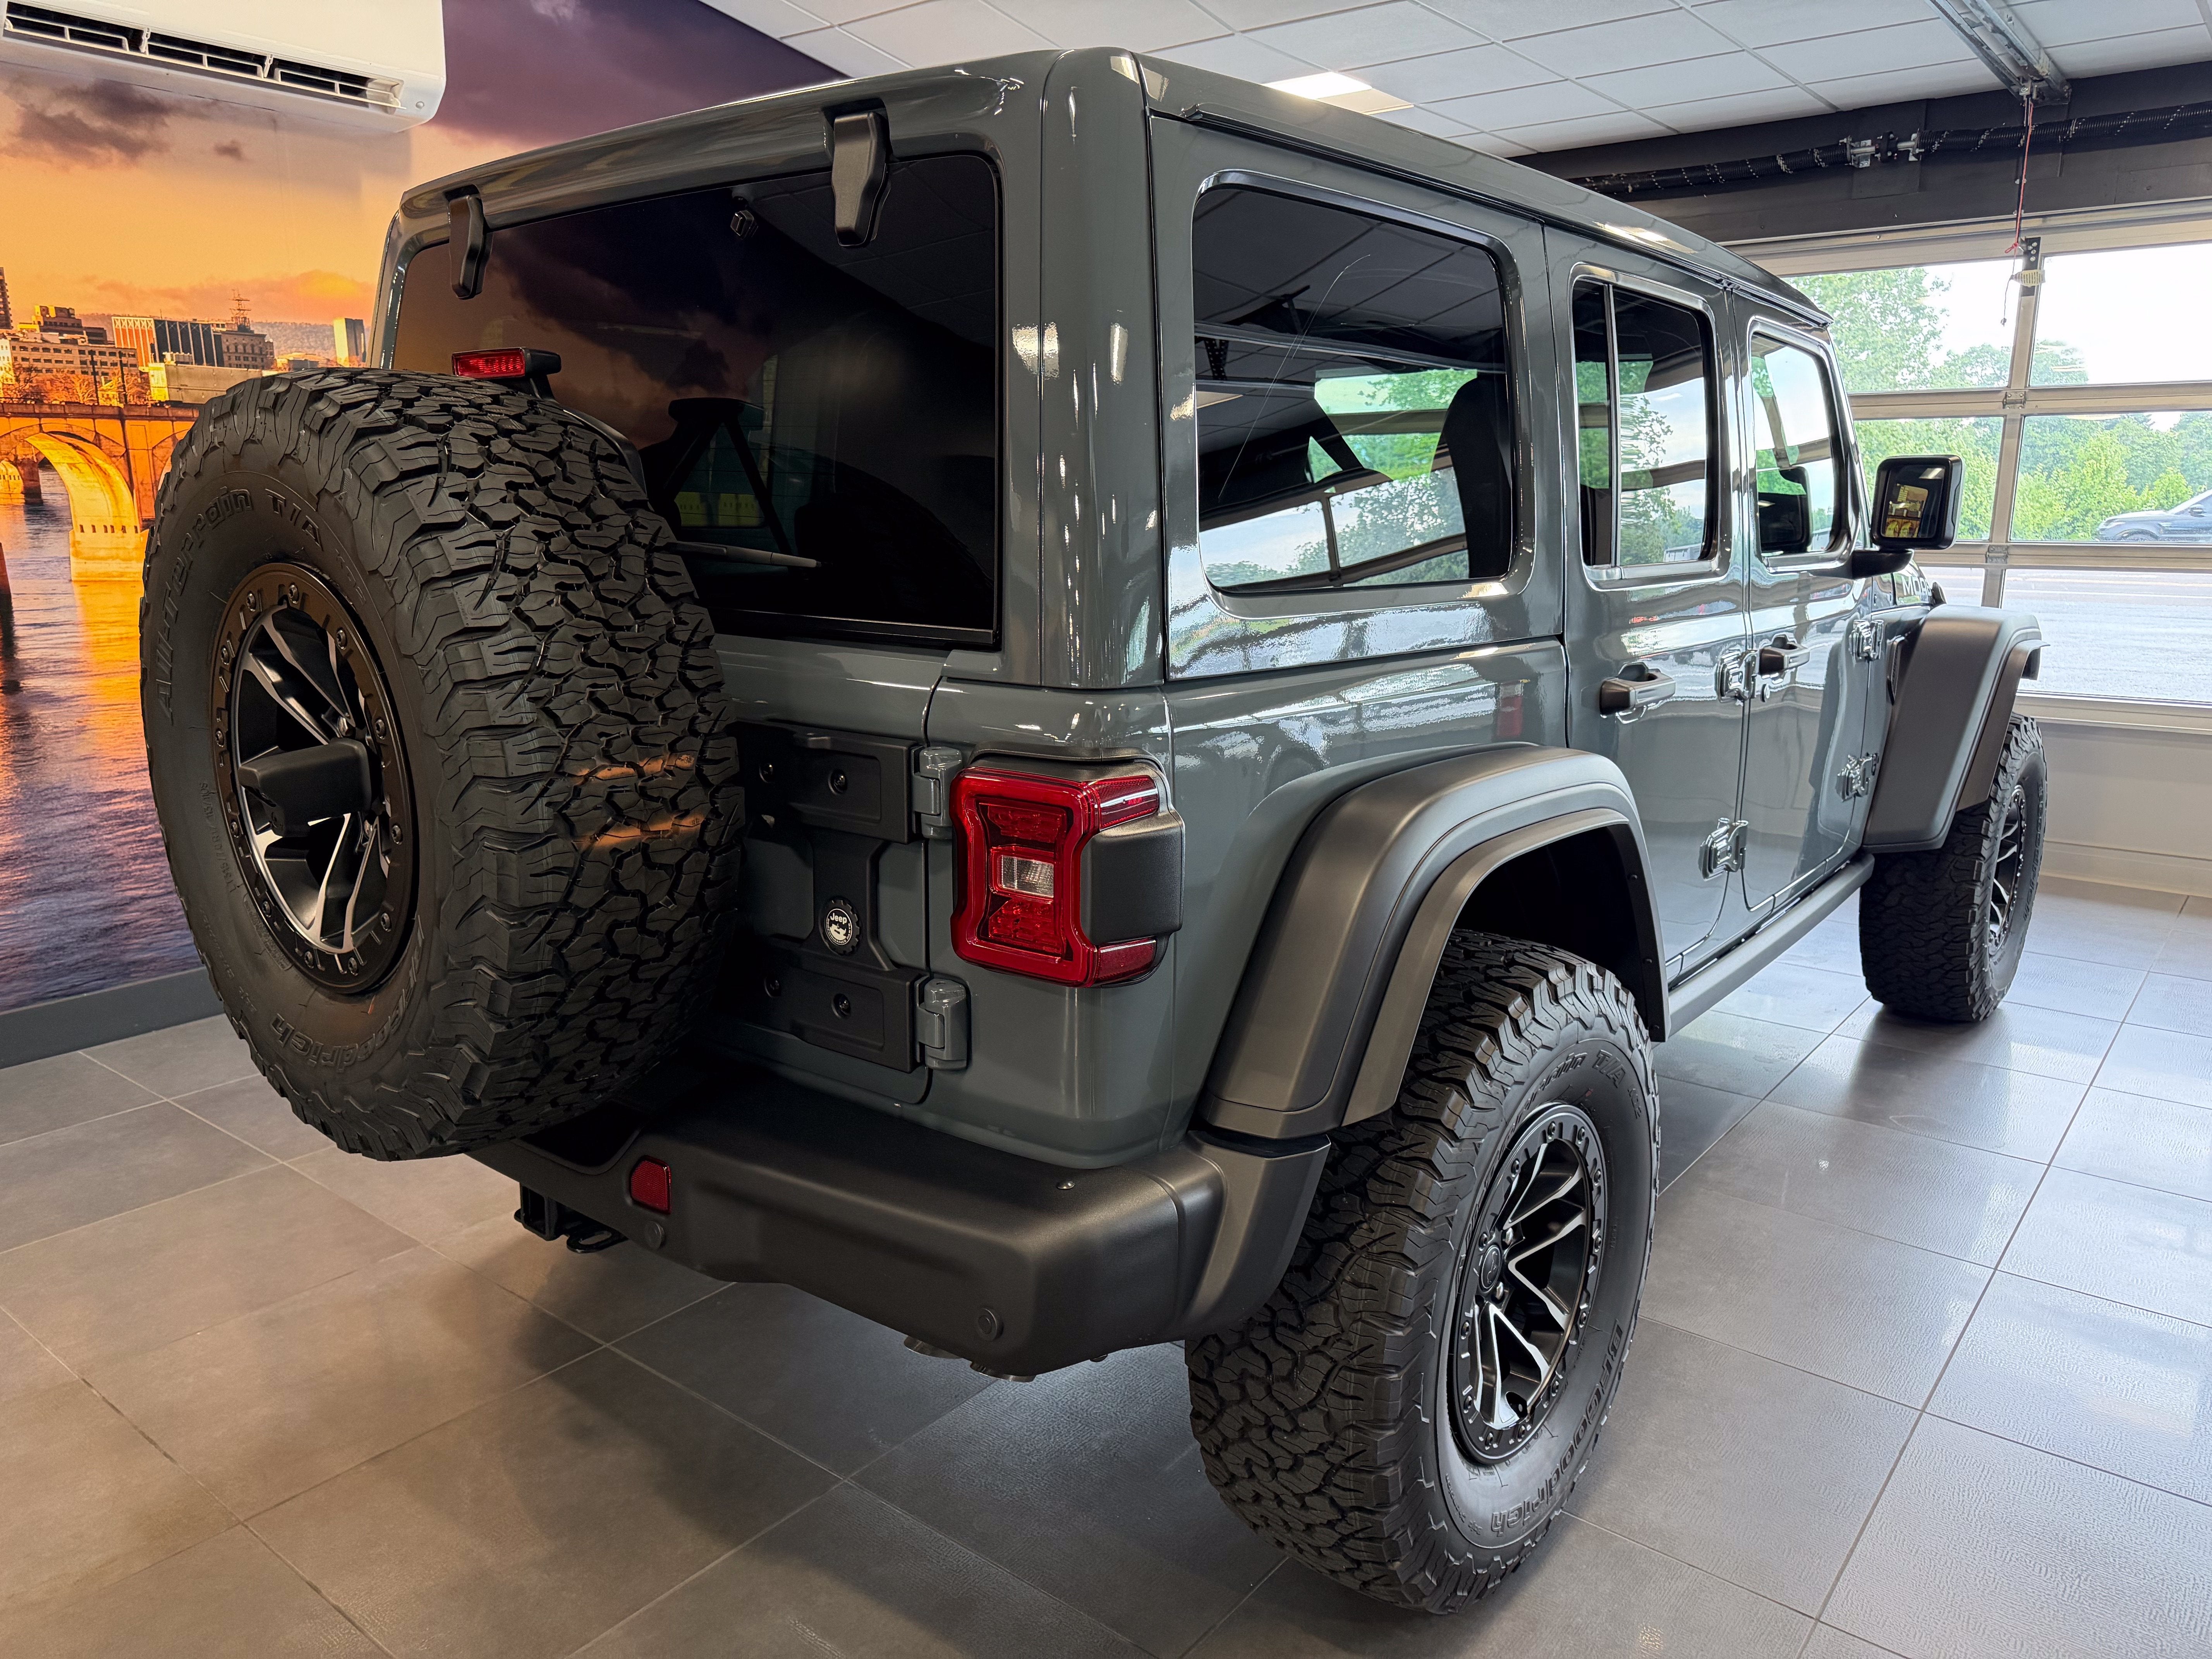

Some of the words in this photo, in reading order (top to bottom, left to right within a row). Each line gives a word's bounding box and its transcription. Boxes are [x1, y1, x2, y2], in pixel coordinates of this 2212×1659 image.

[264, 488, 325, 552] T/A
[830, 912, 847, 925] Jeep
[1592, 1049, 1626, 1088] T/A
[1490, 1319, 1623, 1537] BFGoodrich
